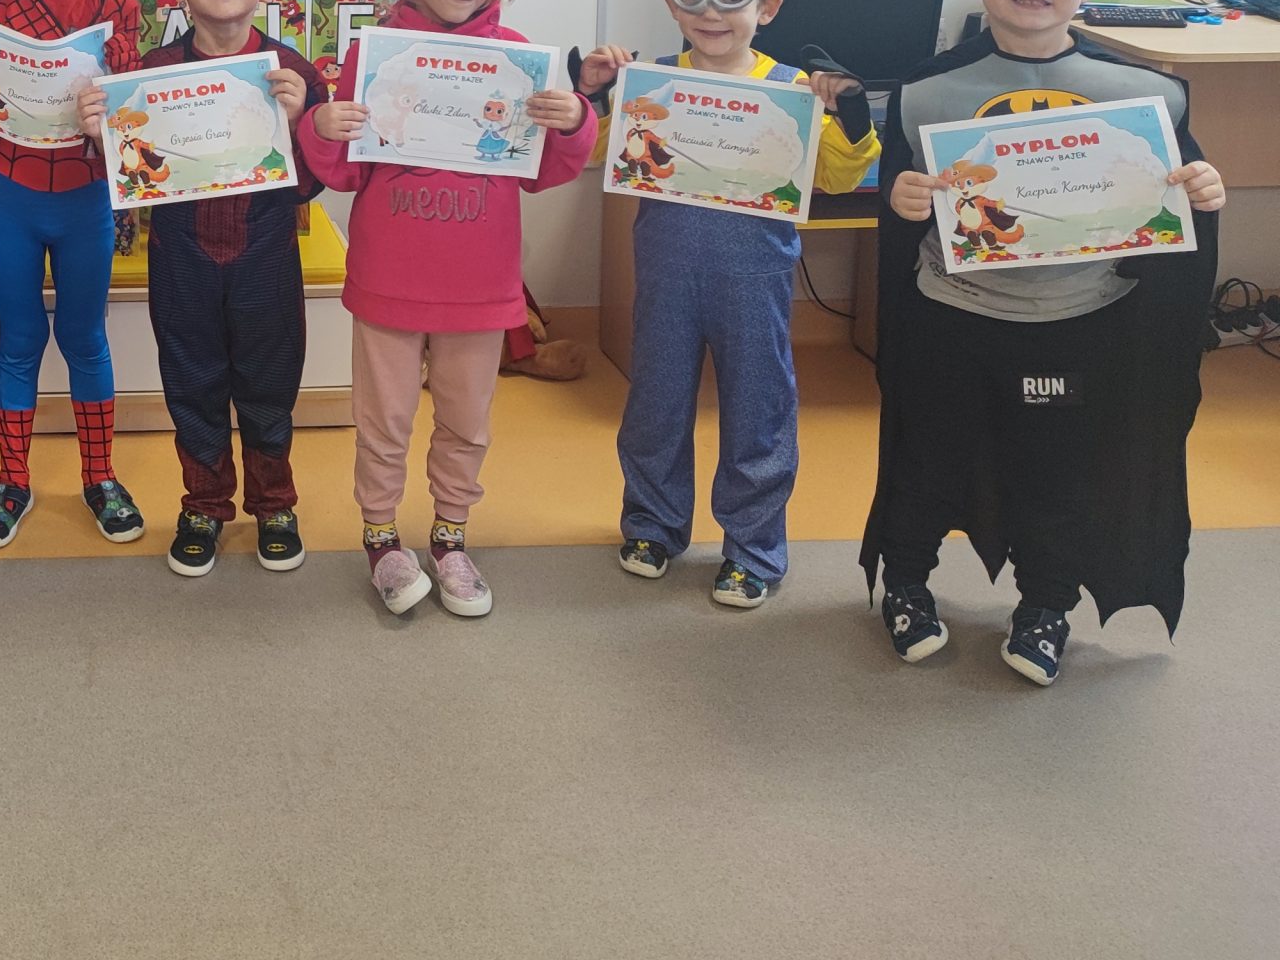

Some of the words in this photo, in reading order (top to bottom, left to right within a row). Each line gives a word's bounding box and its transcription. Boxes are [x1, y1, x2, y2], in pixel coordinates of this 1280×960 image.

[416, 56, 498, 75] DYPLOM
[146, 82, 226, 105] DYPLOM
[673, 91, 760, 115] DYPLOM
[995, 132, 1100, 157] DYPLOM
[1023, 377, 1065, 395] RUN
